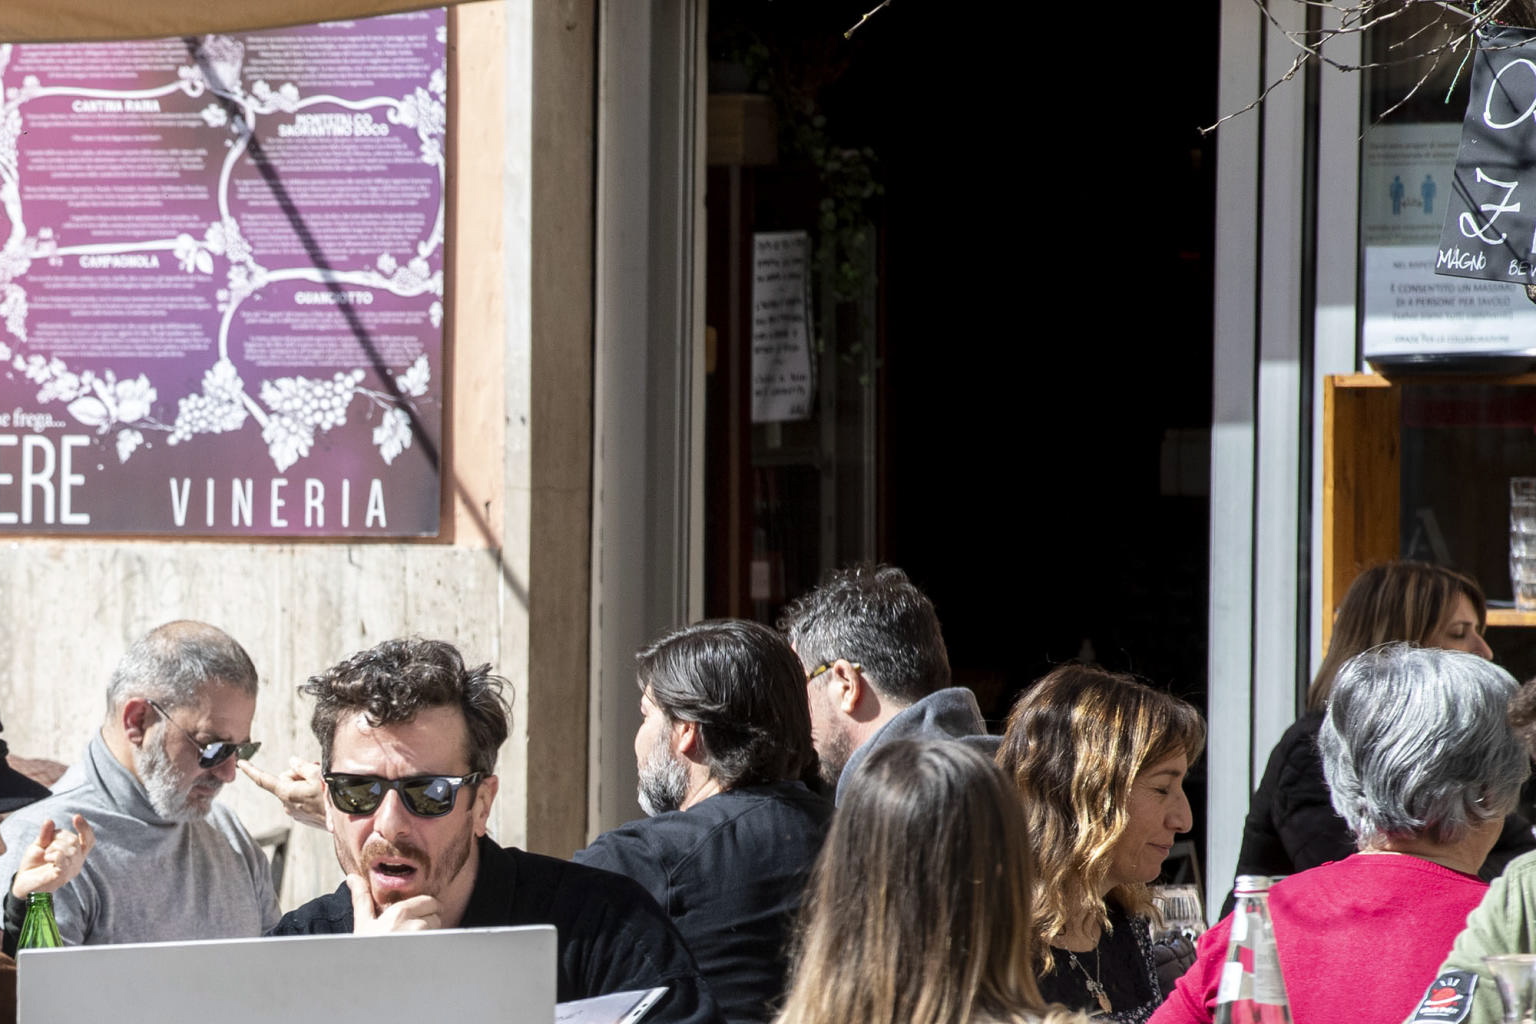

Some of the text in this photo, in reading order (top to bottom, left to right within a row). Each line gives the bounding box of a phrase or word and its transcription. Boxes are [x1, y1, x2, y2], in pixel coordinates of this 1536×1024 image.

[78, 255, 160, 269] CAMPAGNOLA
[1436, 247, 1487, 271] MAGNO
[169, 477, 388, 529] VINERIA
